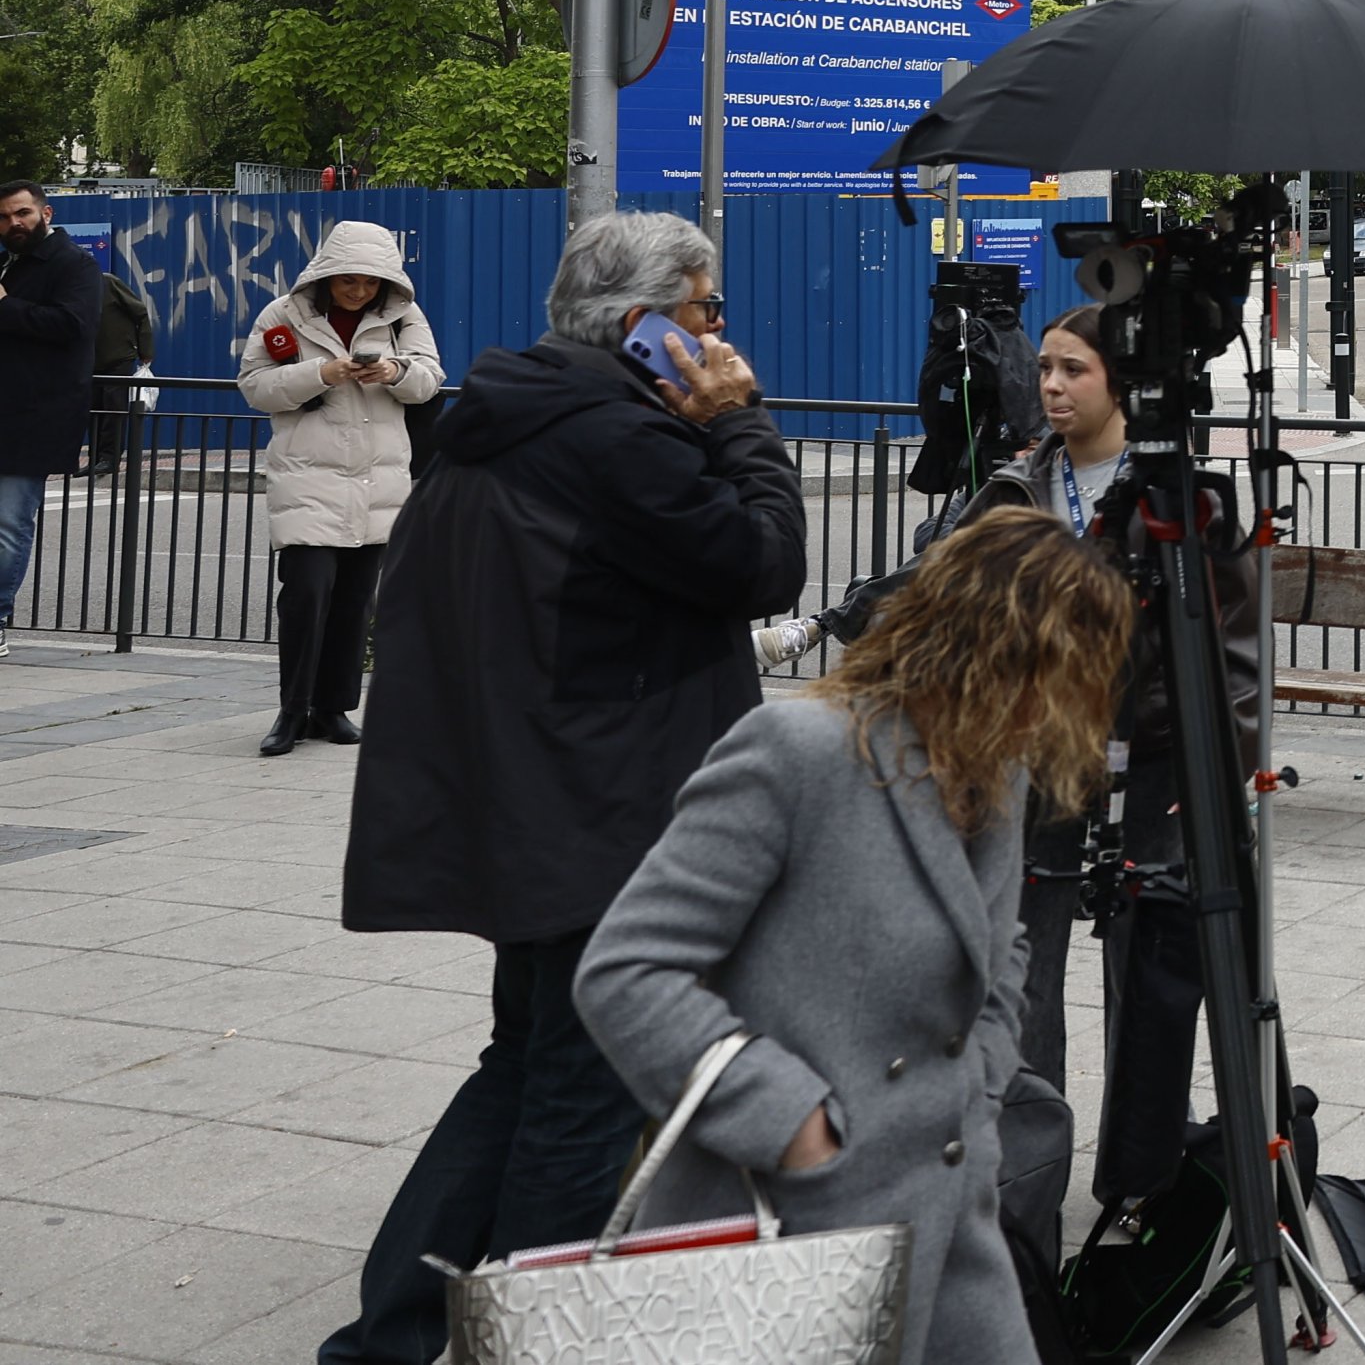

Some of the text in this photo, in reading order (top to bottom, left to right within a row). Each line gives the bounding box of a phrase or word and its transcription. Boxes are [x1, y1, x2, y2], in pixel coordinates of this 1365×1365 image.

[988, 0, 1010, 9] Metro
[673, 8, 697, 23] EN
[729, 10, 817, 29] ESTACIÓN
[822, 15, 845, 31] DE
[849, 17, 971, 37] CARABANCHEL
[726, 50, 799, 66] installation
[802, 54, 816, 67] at
[818, 54, 902, 71] Carabanchel
[820, 98, 851, 108] Budget:
[853, 98, 921, 110] 3.325.814,56
[923, 100, 931, 110] €
[731, 117, 748, 127] DE
[751, 117, 790, 128] OBRA:
[796, 119, 815, 129] Start
[816, 119, 826, 129] of
[825, 121, 848, 129] work:
[850, 118, 885, 134] junio
[891, 122, 912, 133] Jun
[730, 170, 765, 178] ofrecerle
[778, 170, 800, 180] mejor
[801, 170, 833, 178] servicio.
[834, 171, 882, 179] Lamentamos
[883, 171, 894, 179] las
[1044, 174, 1059, 184] RE
